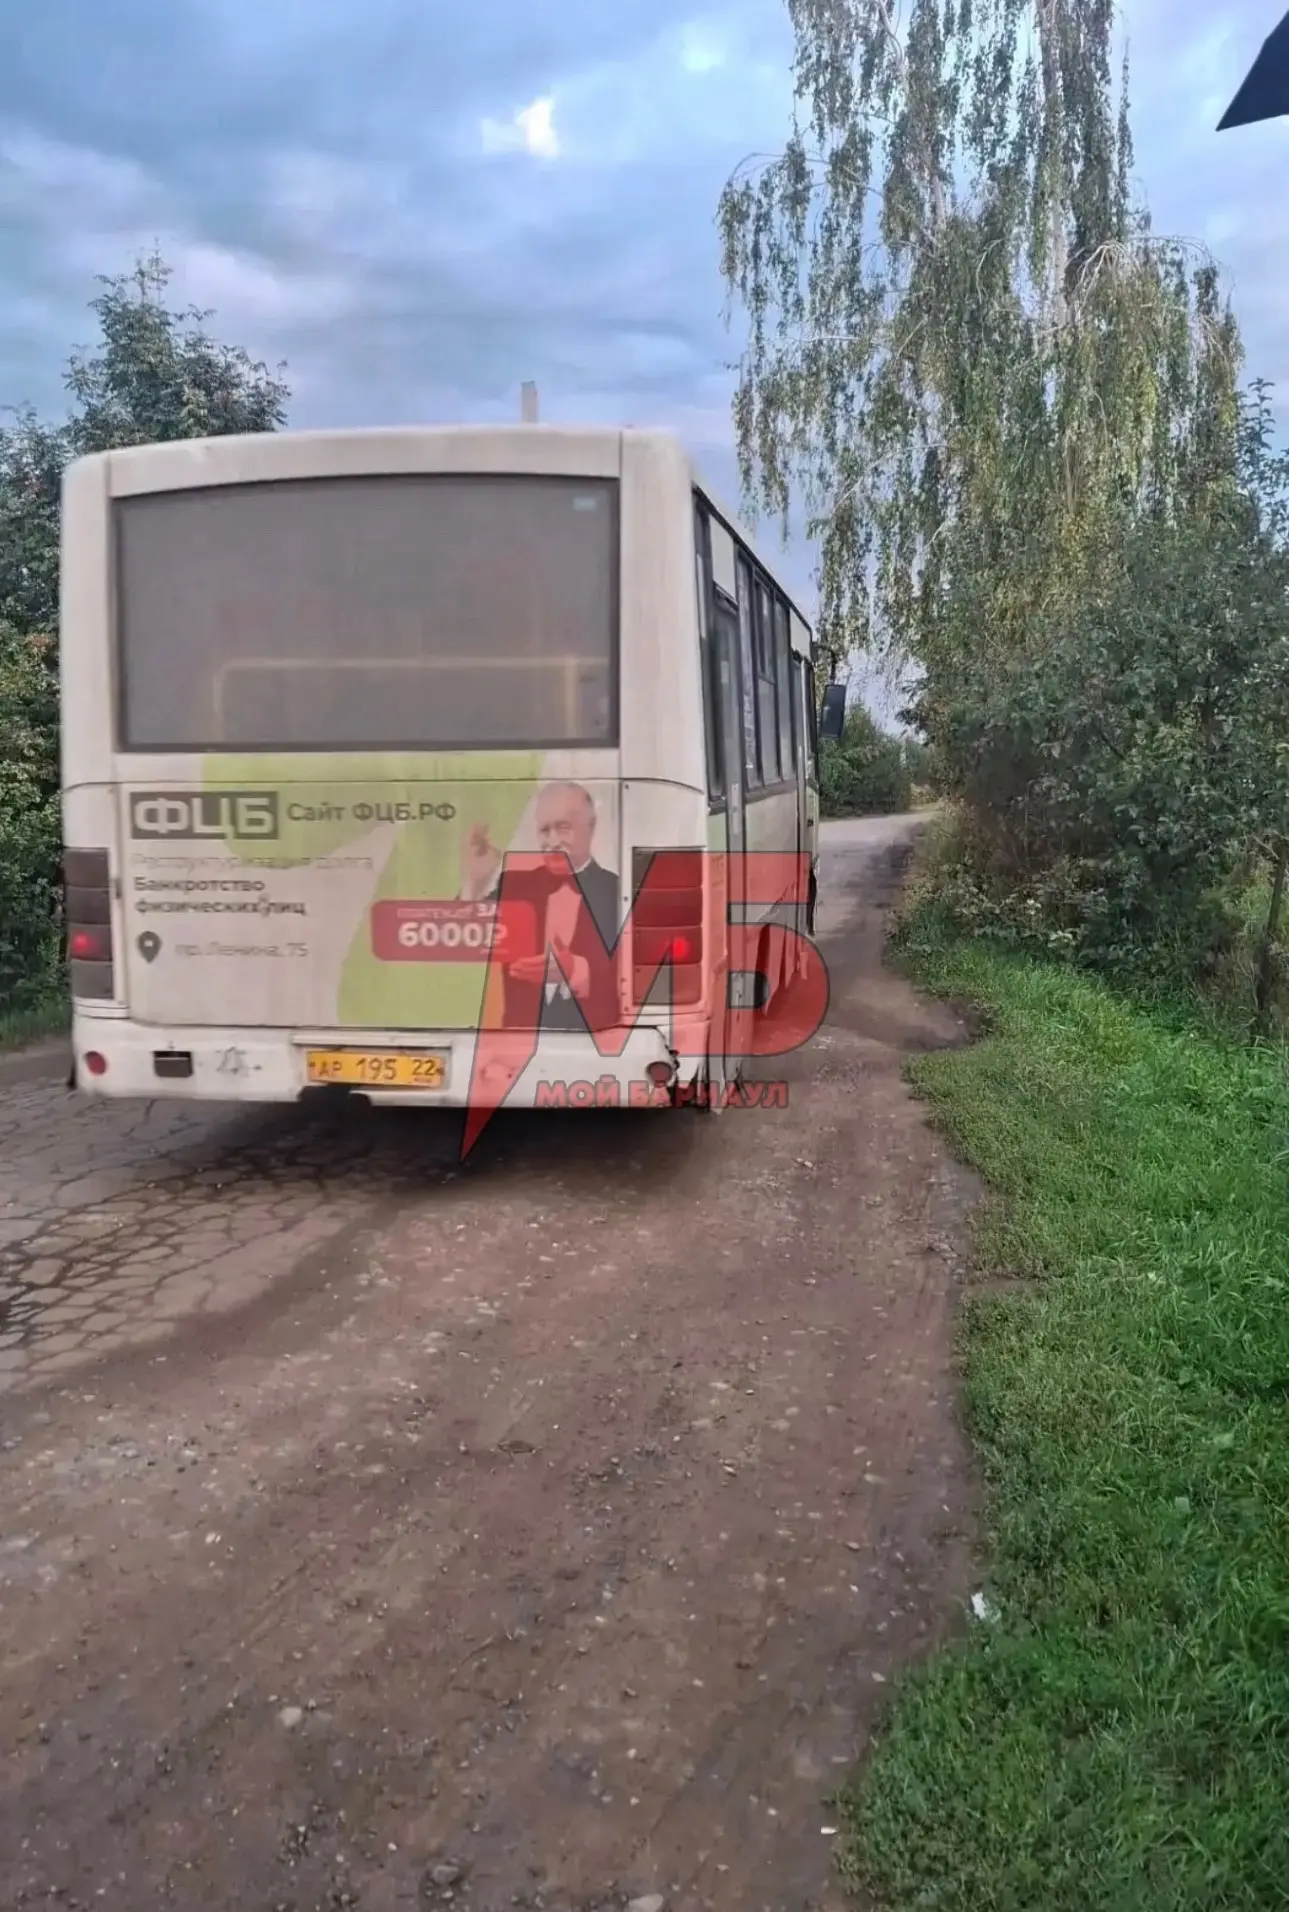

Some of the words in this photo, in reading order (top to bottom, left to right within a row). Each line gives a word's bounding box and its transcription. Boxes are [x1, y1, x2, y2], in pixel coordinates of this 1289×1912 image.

[134, 797, 275, 834] ФЦБ
[287, 803, 344, 821] Сайт
[352, 802, 456, 823] ФЦБ.РФ
[133, 877, 265, 894] Банкротство
[357, 1058, 397, 1080] 195
[412, 1059, 437, 1076] 22
